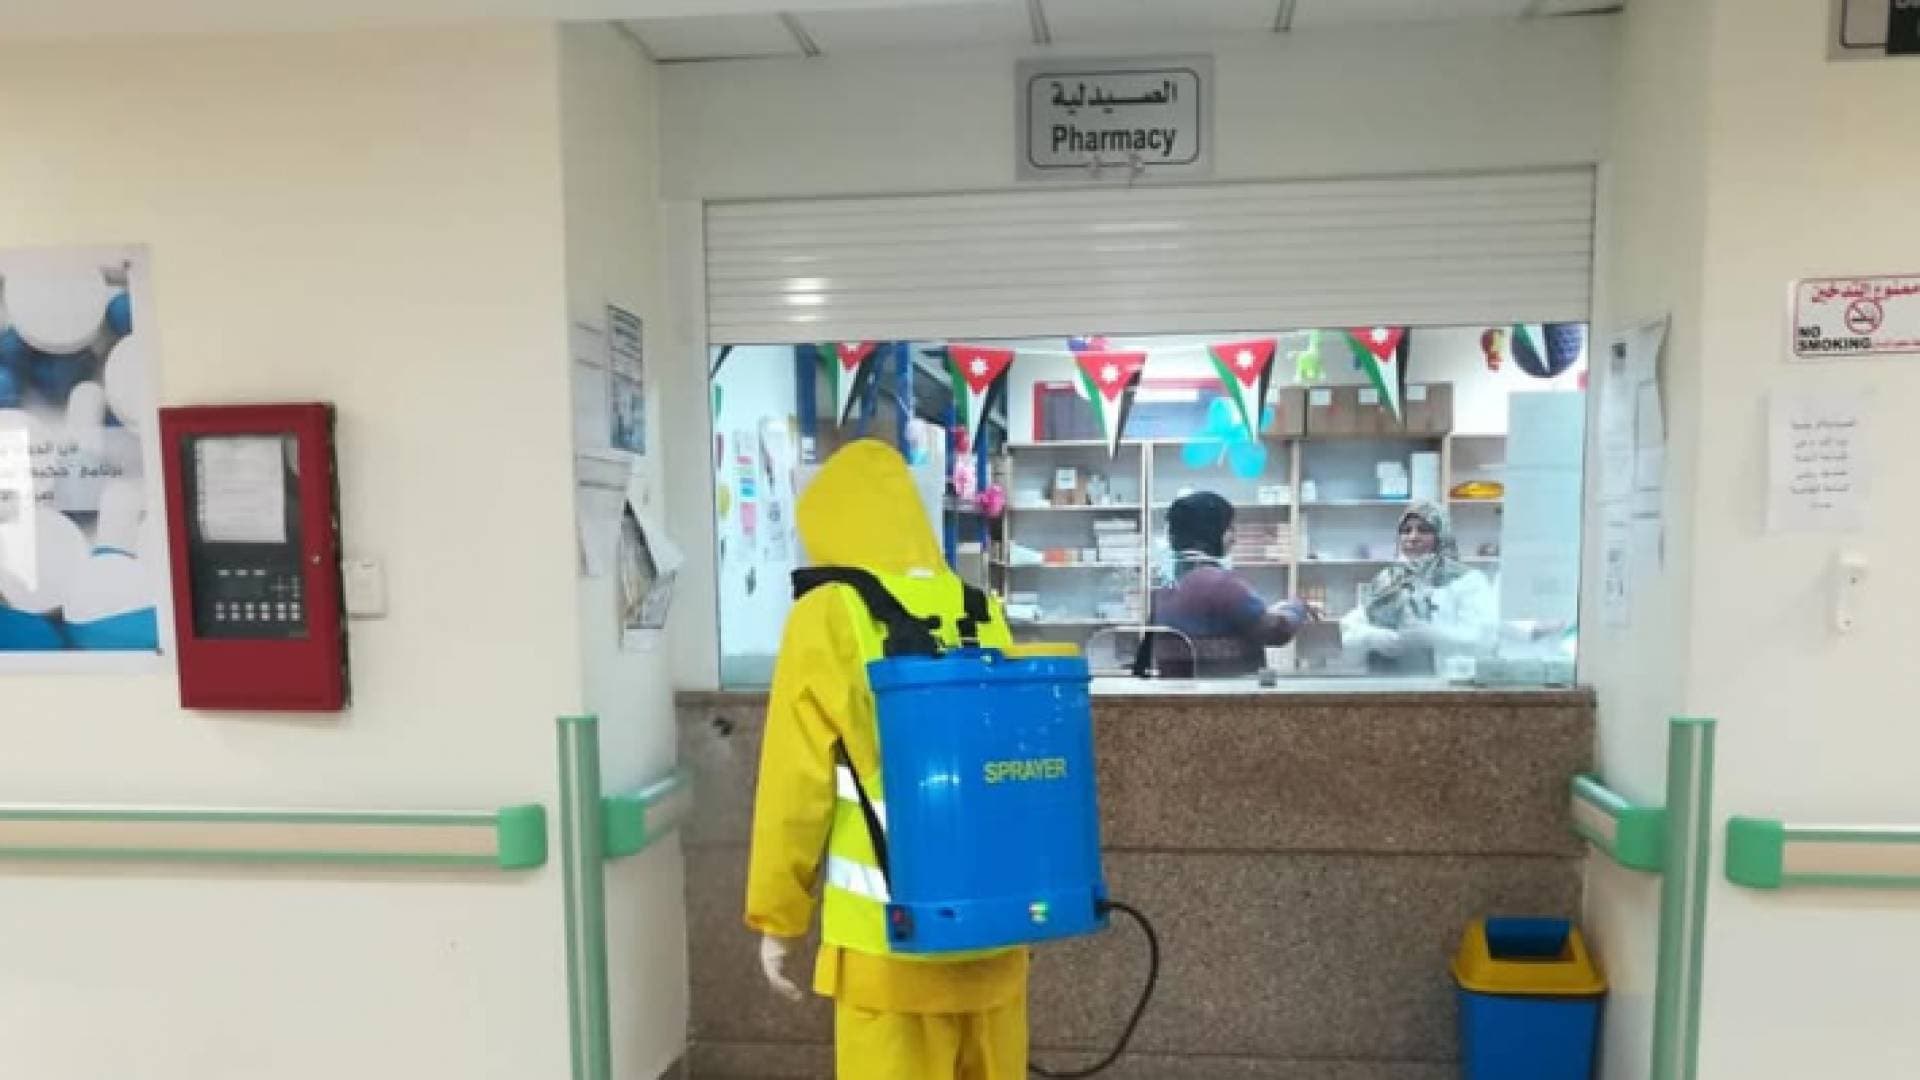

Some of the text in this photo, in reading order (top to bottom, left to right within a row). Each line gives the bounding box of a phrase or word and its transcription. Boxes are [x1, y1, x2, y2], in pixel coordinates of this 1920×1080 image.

[1051, 124, 1177, 156] Pharmacy
[1798, 326, 1821, 338] NO
[1798, 337, 1872, 352] SMOKING
[984, 758, 1067, 784] SPRAYER
